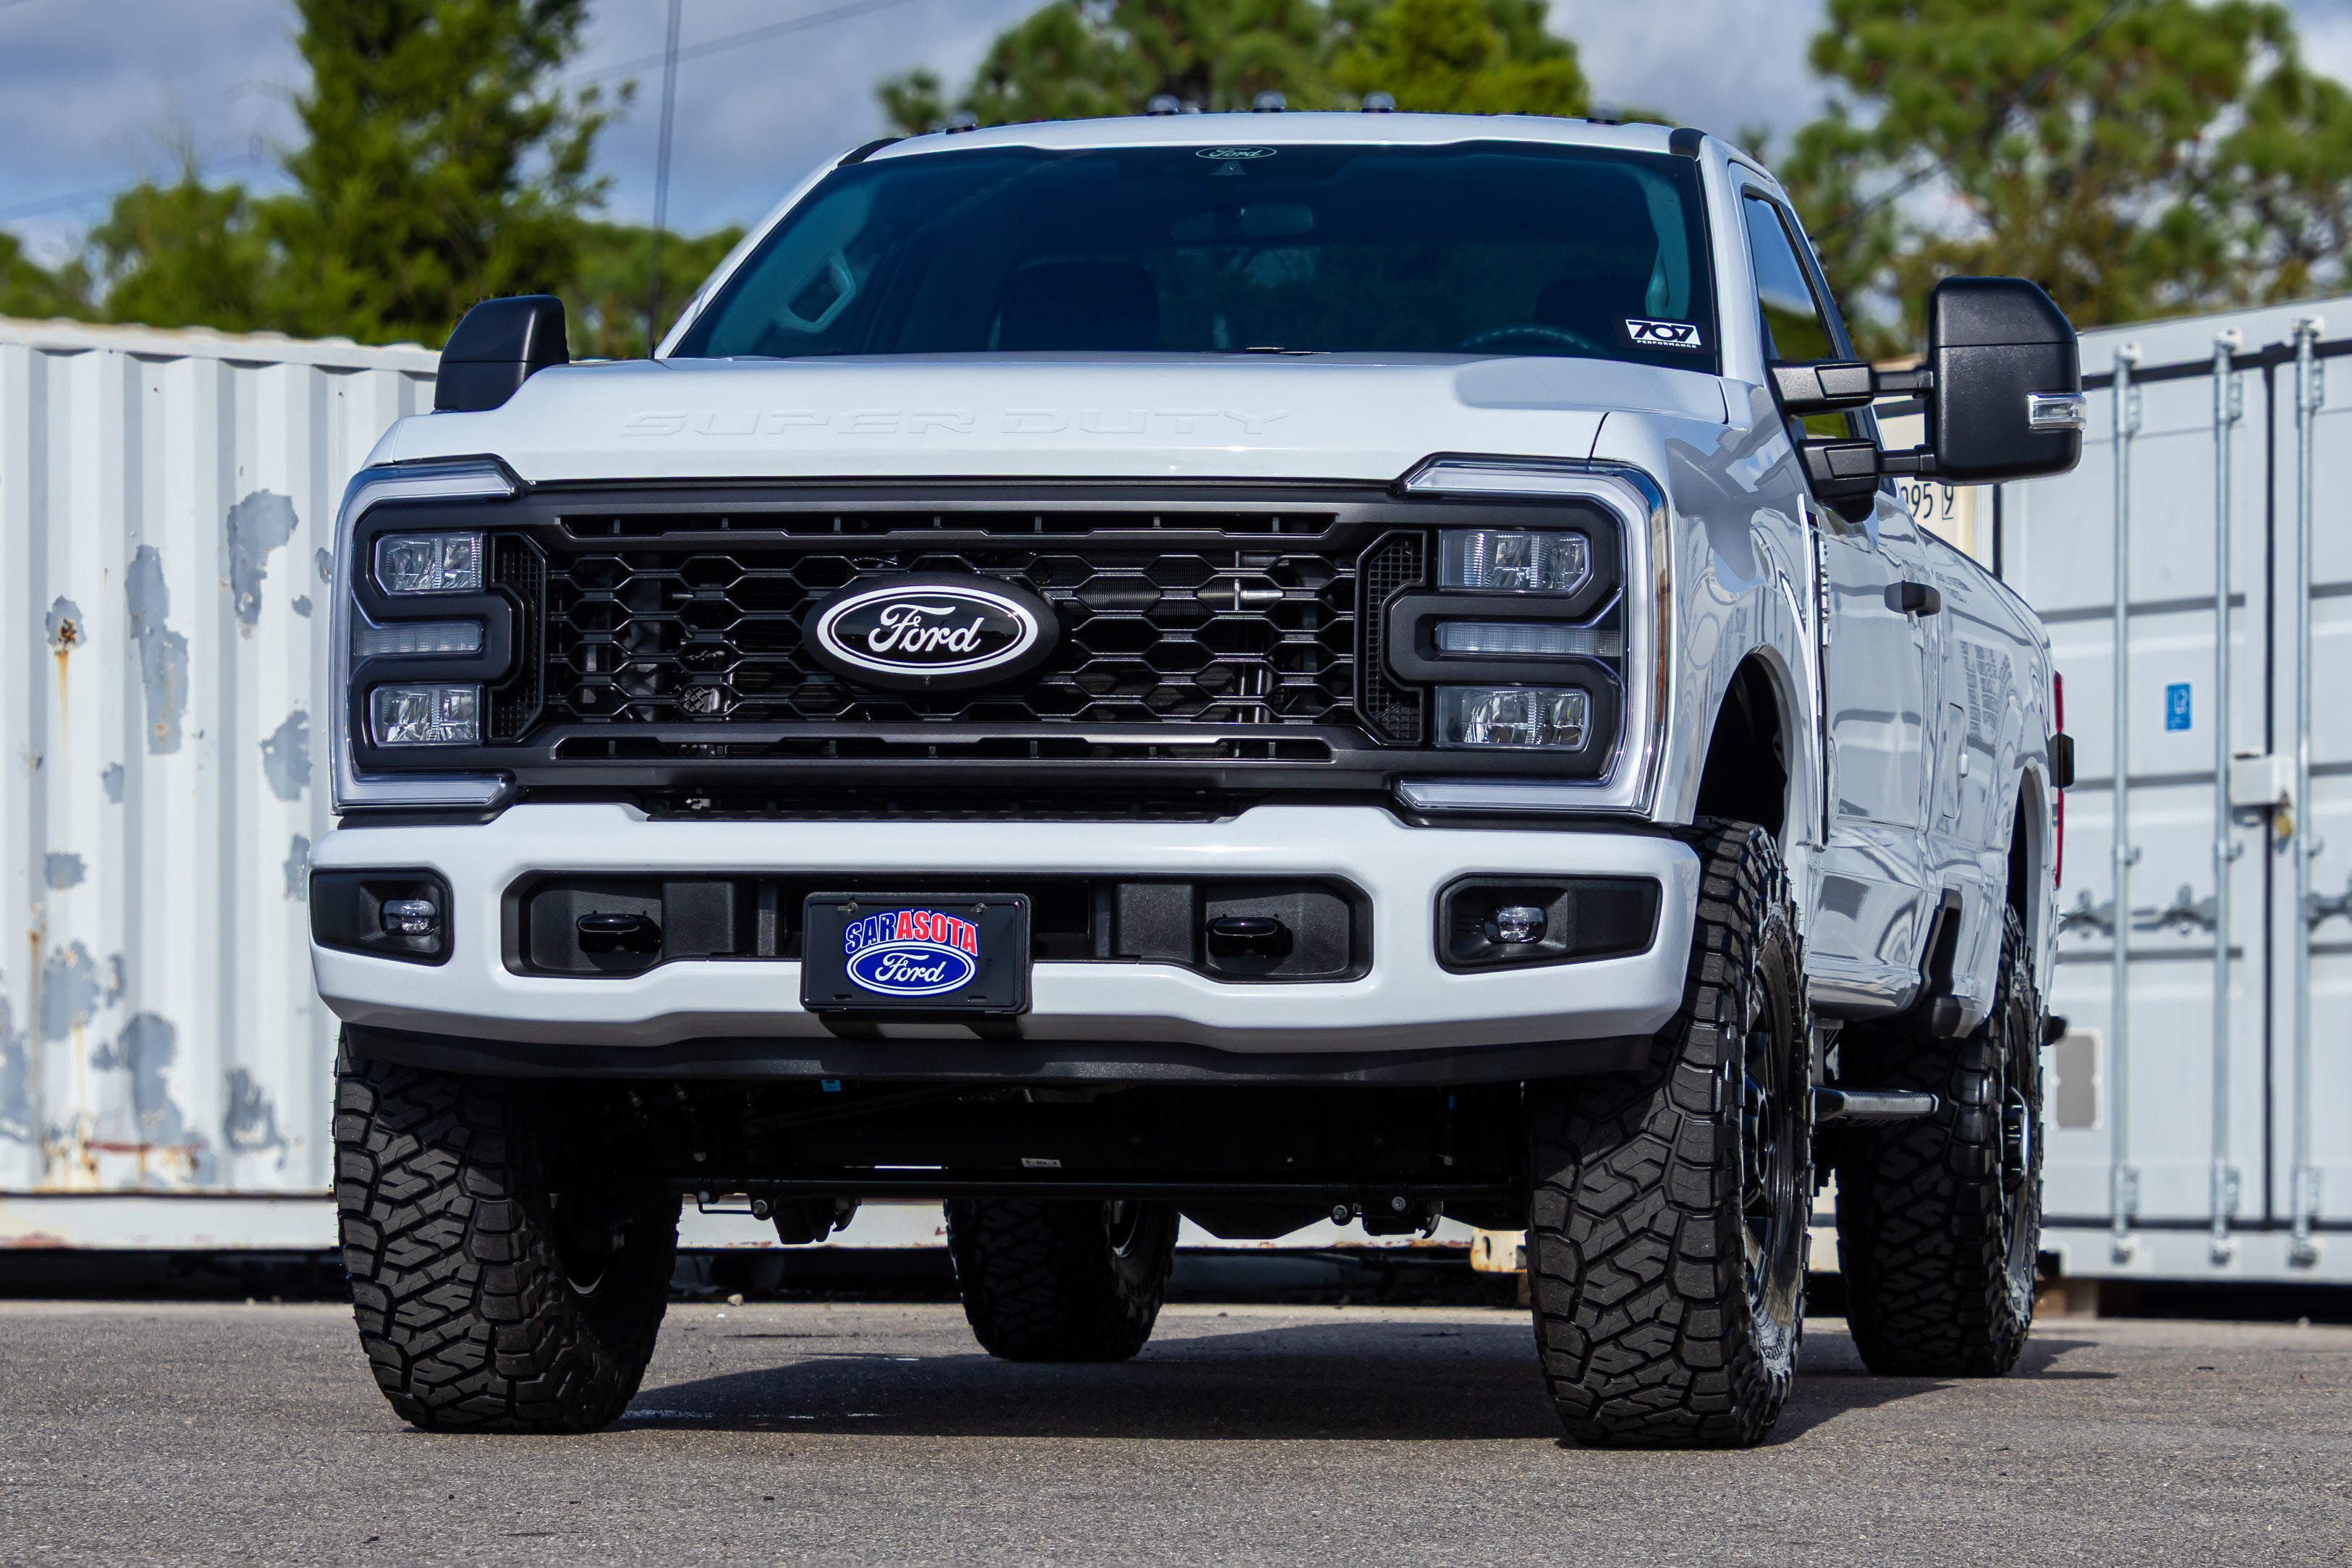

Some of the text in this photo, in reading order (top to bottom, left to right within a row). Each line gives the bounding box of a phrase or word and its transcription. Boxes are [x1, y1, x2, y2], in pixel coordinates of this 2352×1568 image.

[1209, 147, 1264, 158] Ford
[1628, 321, 1694, 343] 707
[1636, 339, 1697, 349] PERFORMANCE
[622, 408, 1290, 436] SUPER DUTY
[868, 603, 985, 653] Ford
[845, 910, 979, 957] SARASOTA
[874, 952, 947, 983] Ford
